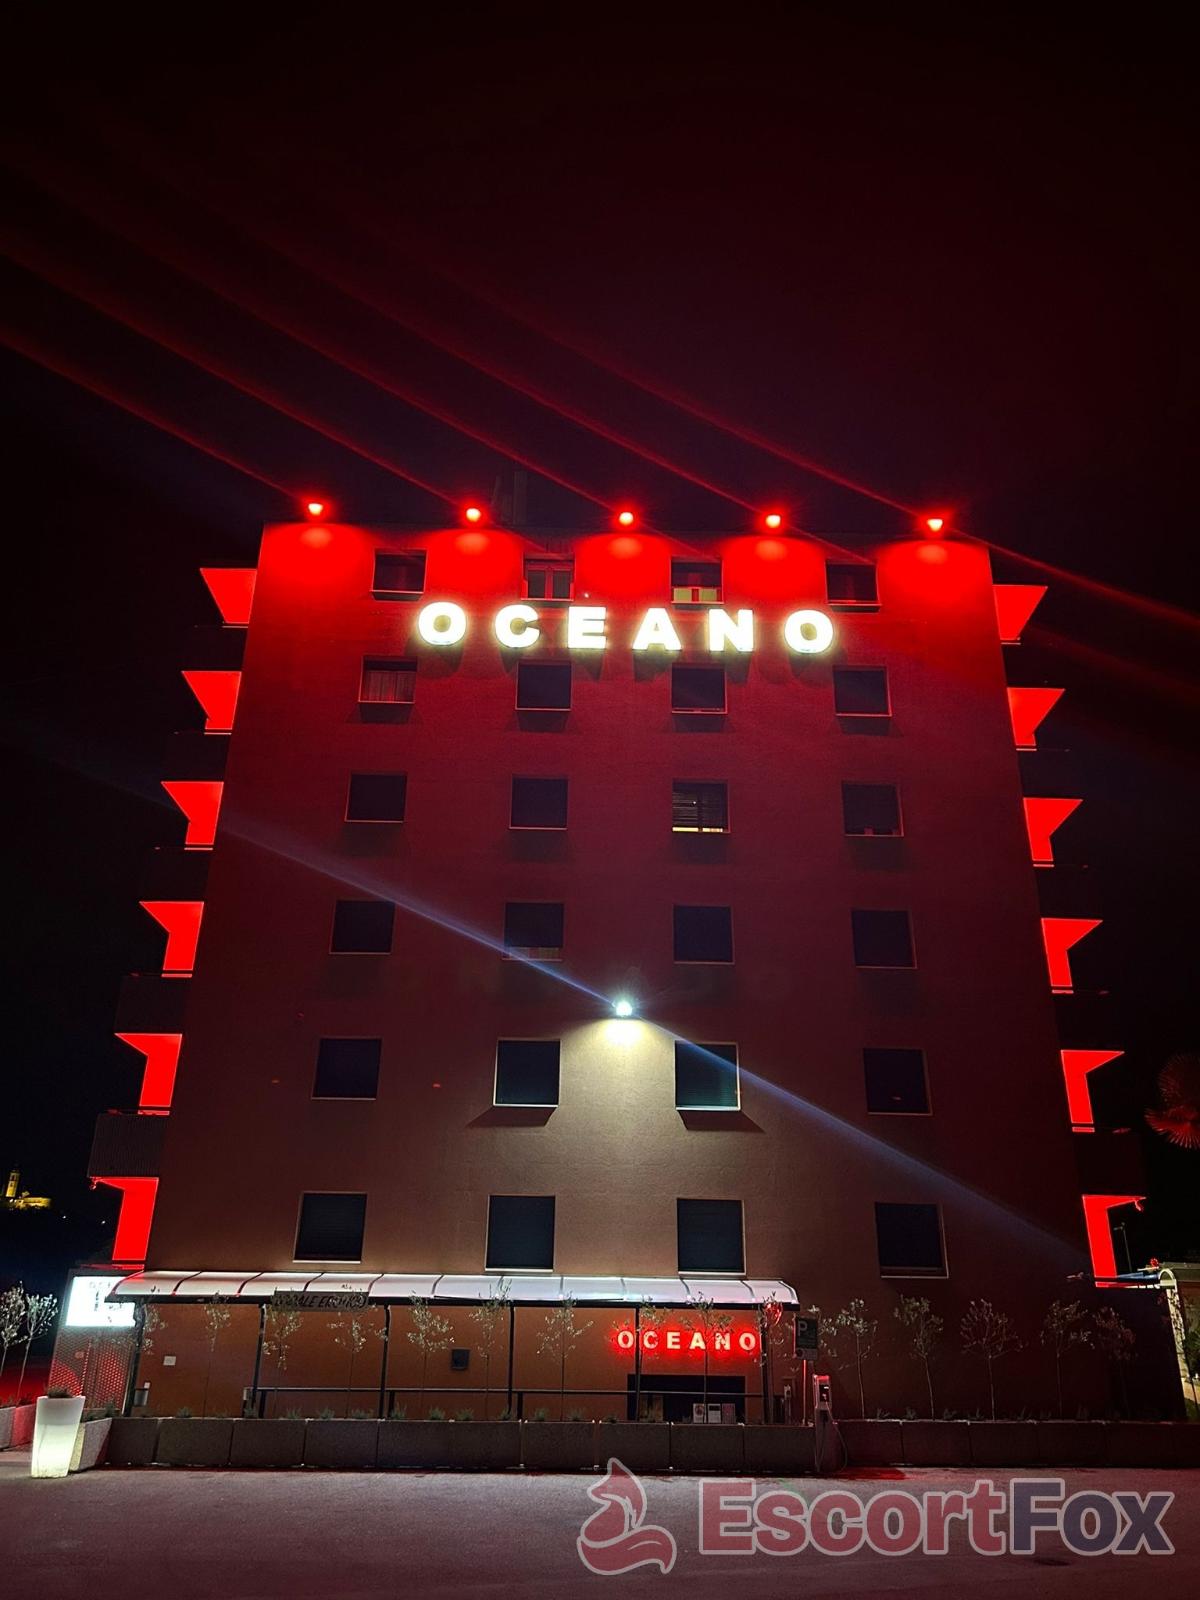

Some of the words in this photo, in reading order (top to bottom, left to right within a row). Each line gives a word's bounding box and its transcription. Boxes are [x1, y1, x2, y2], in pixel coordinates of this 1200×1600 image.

[418, 602, 834, 653] OCEANO
[798, 1320, 808, 1336] P
[617, 1331, 756, 1351] OCEANO
